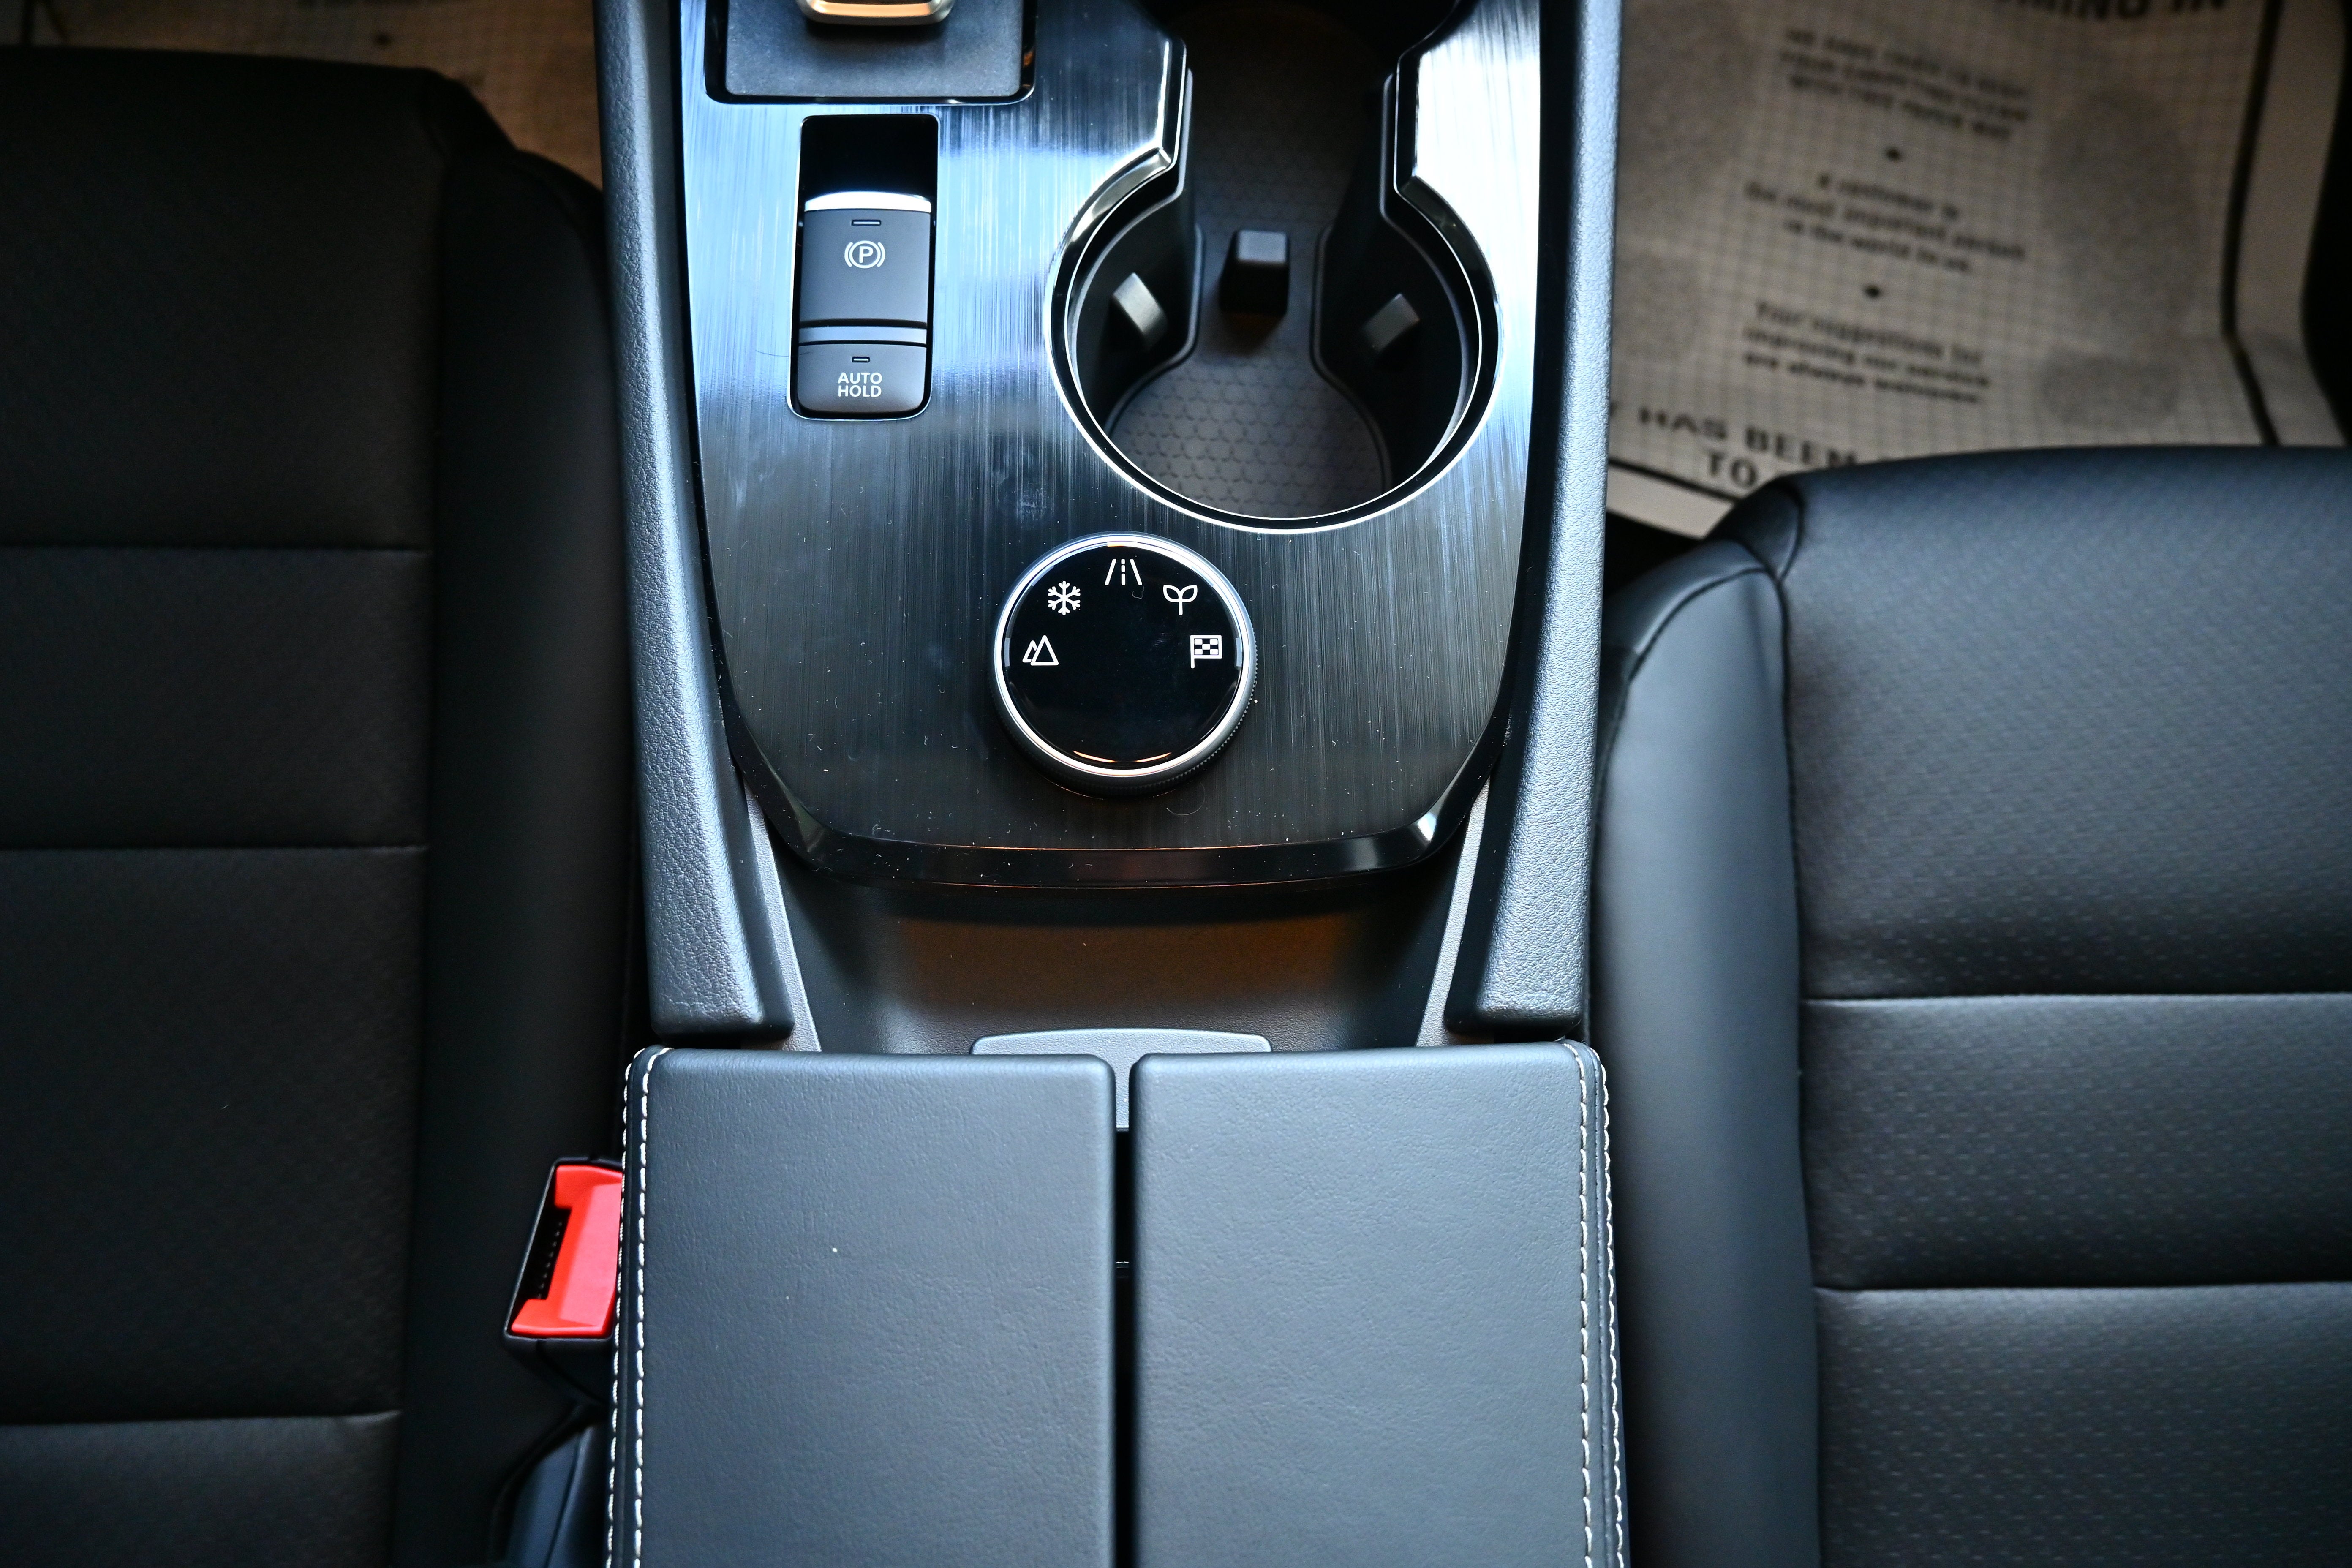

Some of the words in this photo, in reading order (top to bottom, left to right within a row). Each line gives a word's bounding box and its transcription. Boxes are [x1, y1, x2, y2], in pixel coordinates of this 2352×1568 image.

[838, 372, 882, 384] AUTO
[838, 385, 882, 397] HOLD
[1639, 406, 1727, 441] HAS
[1709, 450, 1759, 488] TO
